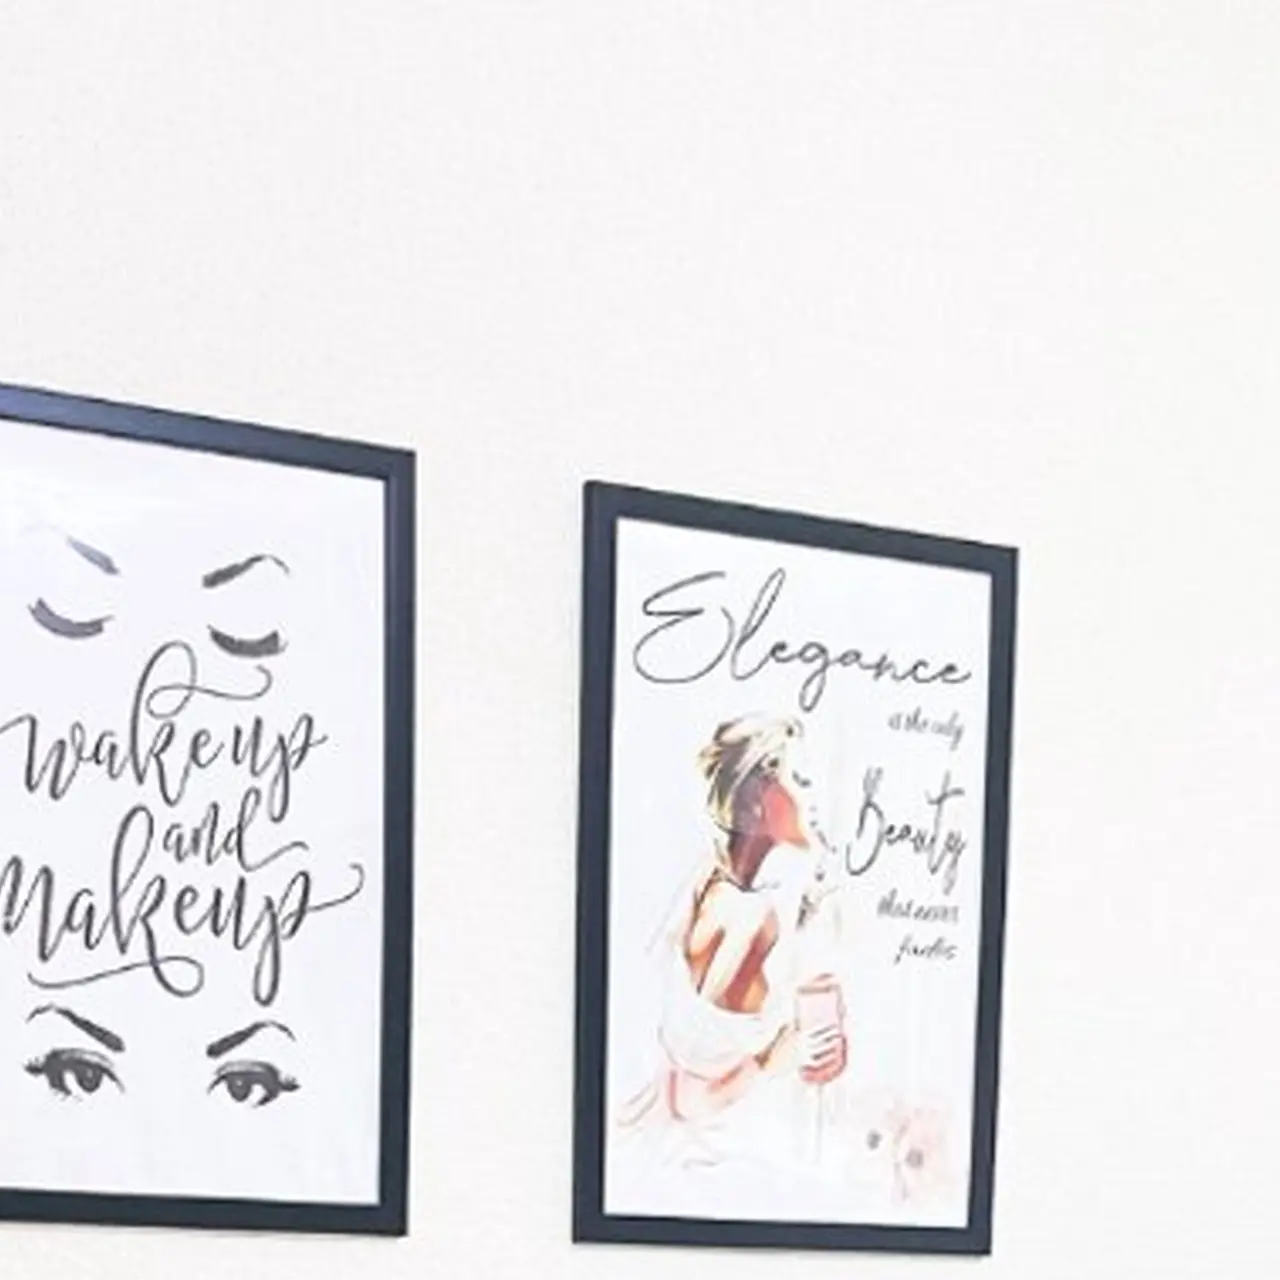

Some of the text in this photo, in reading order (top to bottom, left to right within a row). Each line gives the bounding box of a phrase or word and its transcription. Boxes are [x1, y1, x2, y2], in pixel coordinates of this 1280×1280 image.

[633, 568, 972, 713] Elegance
[162, 786, 310, 873] and
[844, 766, 968, 895] Beauty
